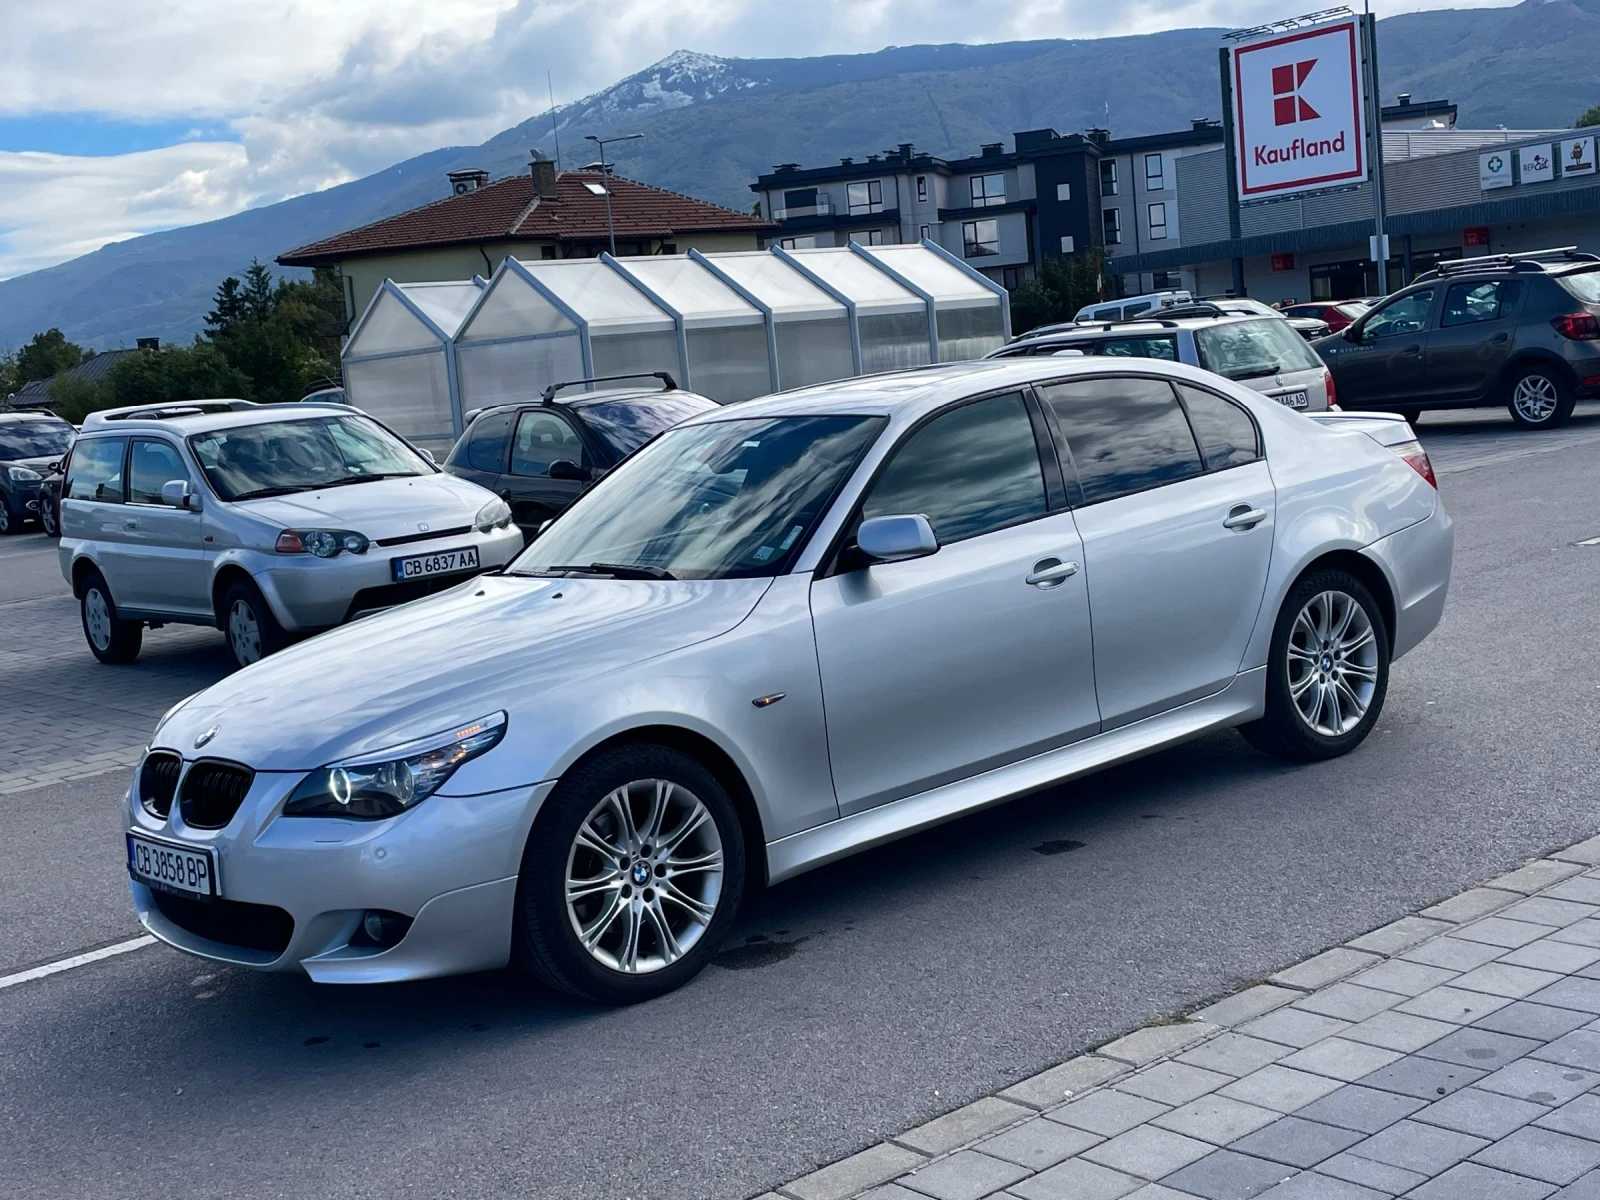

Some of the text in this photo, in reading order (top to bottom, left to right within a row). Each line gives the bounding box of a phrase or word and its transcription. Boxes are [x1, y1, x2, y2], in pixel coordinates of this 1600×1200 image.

[1254, 130, 1345, 167] Kaufland
[1295, 393, 1306, 405] AB
[405, 552, 475, 575] CB 6837 AA
[136, 843, 206, 888] CB 3858 BP
